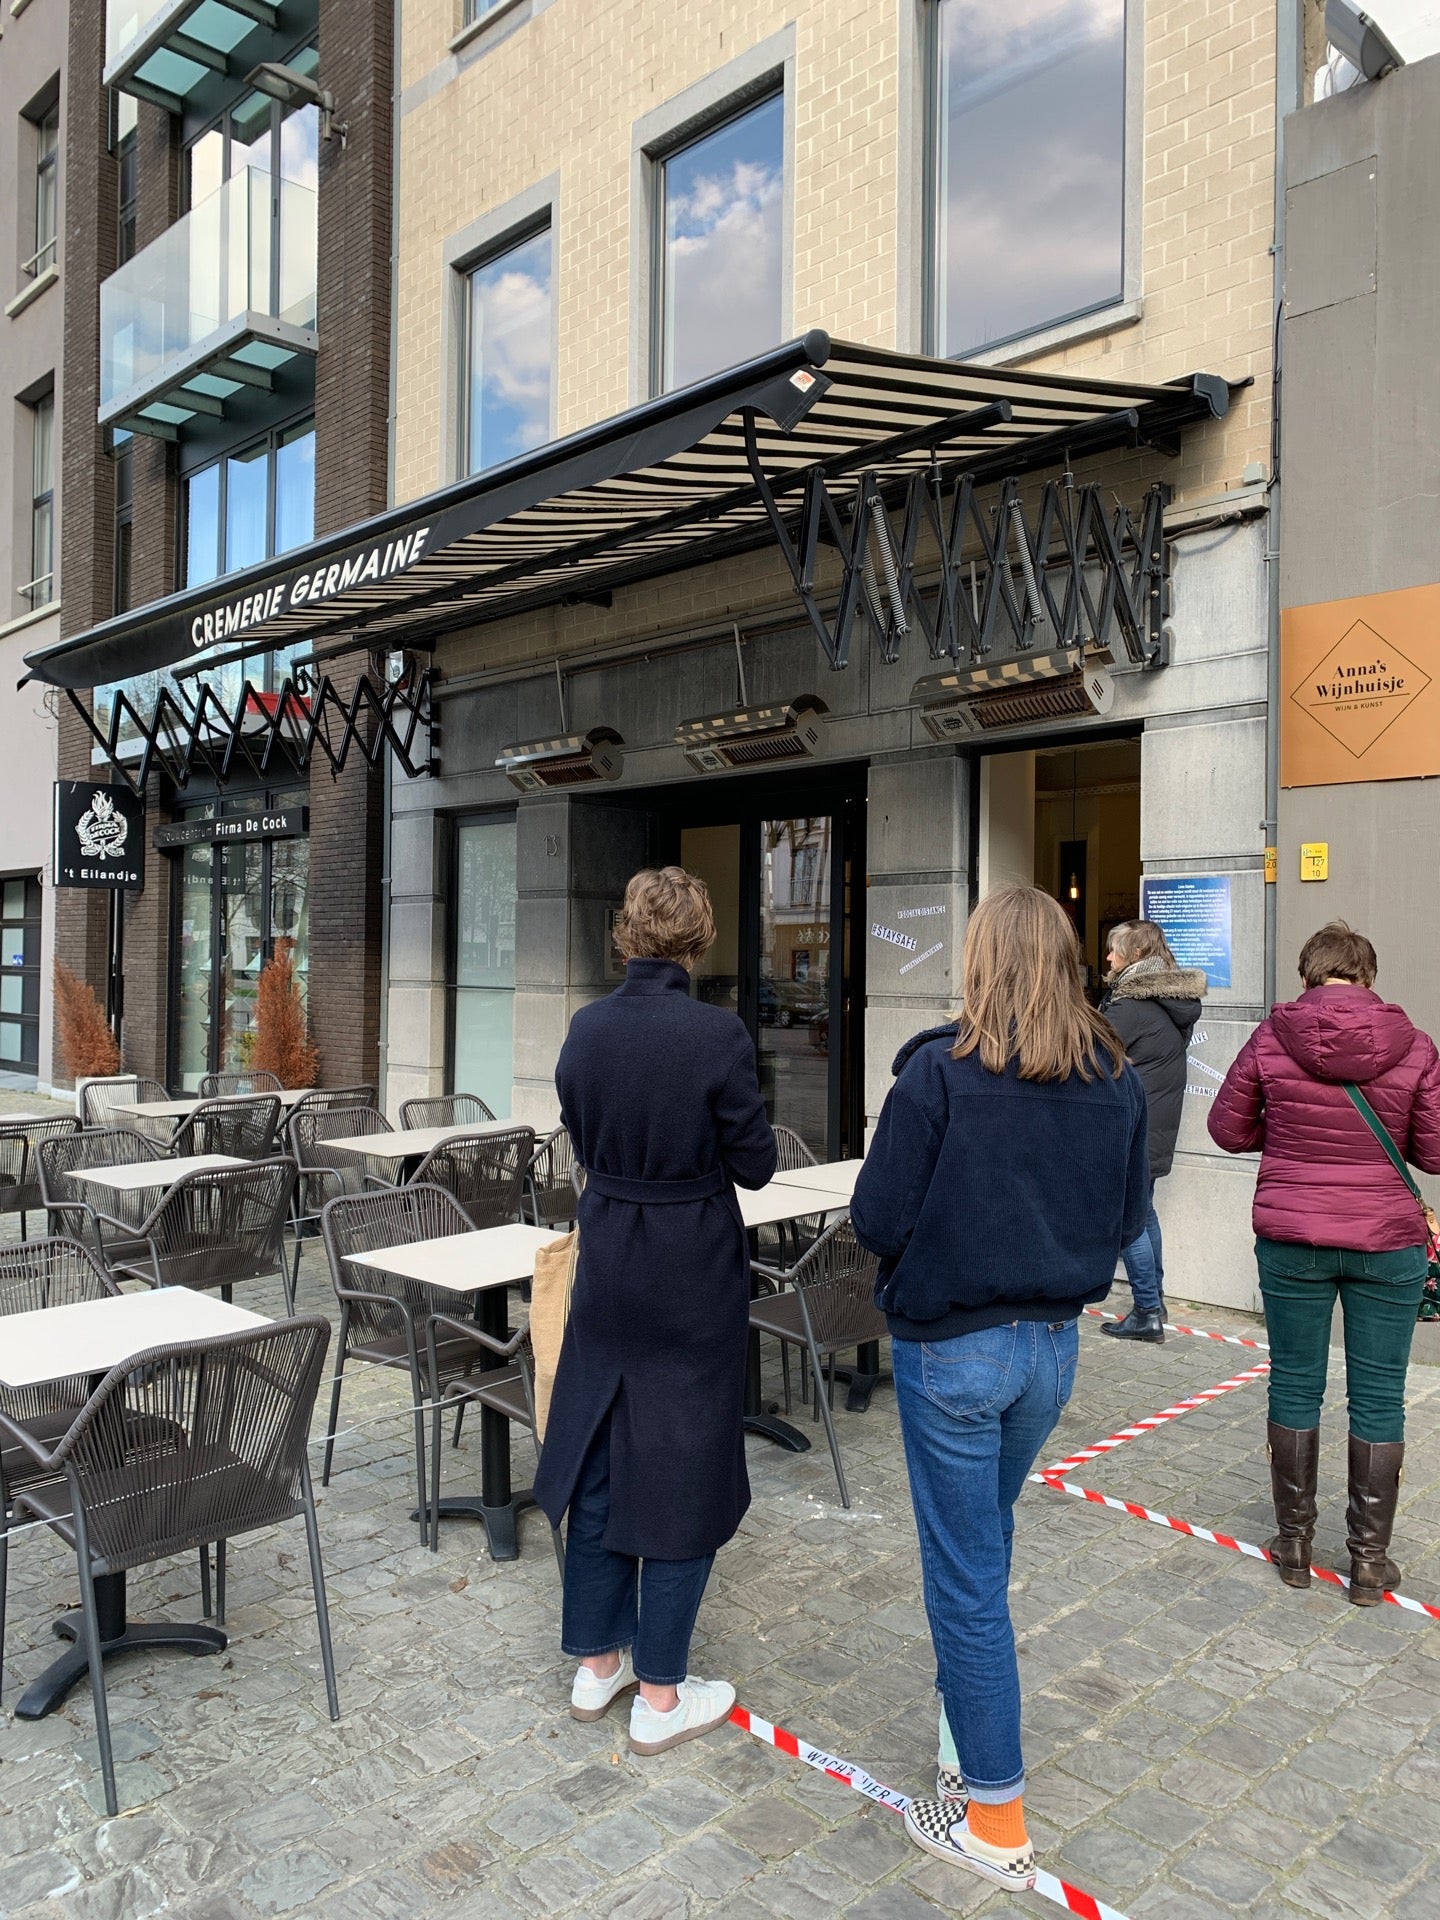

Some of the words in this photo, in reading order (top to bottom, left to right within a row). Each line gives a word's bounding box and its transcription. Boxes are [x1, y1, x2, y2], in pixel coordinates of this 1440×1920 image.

[191, 584, 286, 648] CREMERIE
[289, 527, 430, 606] GERMAINE
[1332, 659, 1387, 679] Anna's
[1315, 676, 1405, 699] Wijnhuisje
[1335, 703, 1352, 712] WIJN
[1360, 701, 1383, 709] KUNST
[215, 823, 242, 836] Firma
[245, 819, 258, 832] De
[262, 815, 287, 831] Cock
[542, 833, 558, 856] 13
[80, 868, 137, 882] Eilandje
[872, 923, 918, 951] #STAYSAFE
